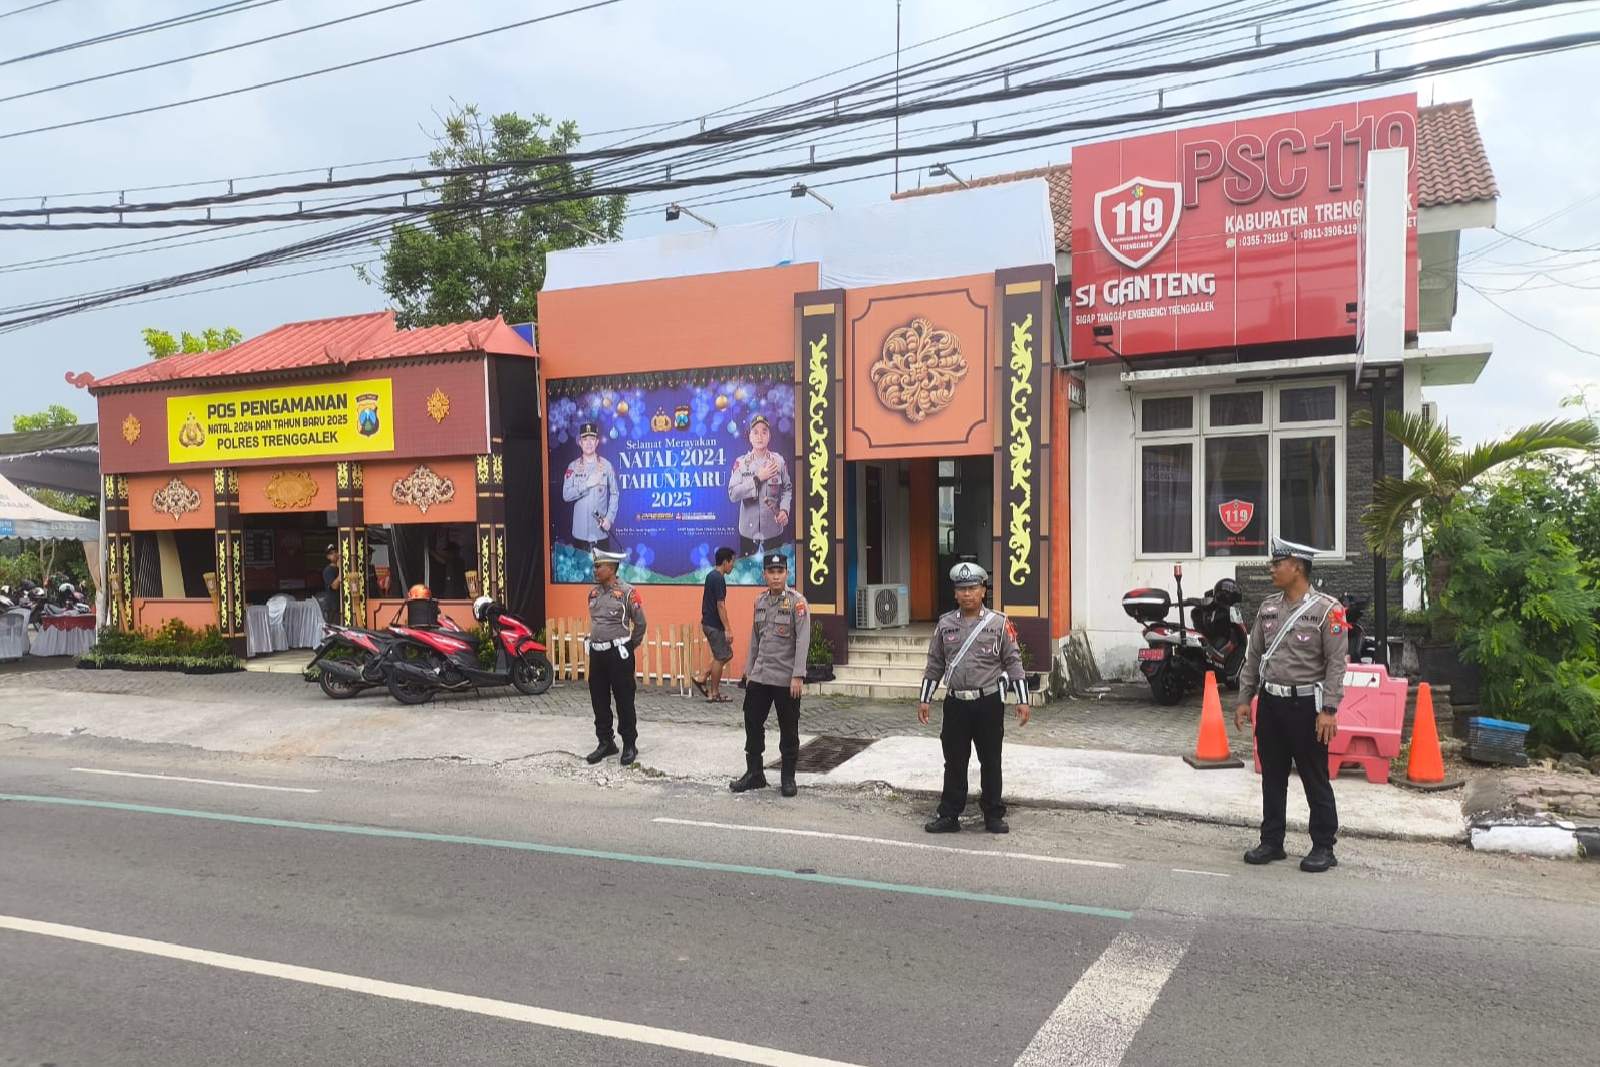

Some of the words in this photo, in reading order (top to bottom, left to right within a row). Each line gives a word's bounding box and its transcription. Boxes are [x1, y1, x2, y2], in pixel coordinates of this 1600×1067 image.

[1182, 127, 1308, 208] PSC
[1111, 197, 1164, 236] 119
[1225, 206, 1308, 233] KABUPATEN
[1075, 284, 1096, 308] SI
[1103, 273, 1216, 306] GANTENG
[1075, 314, 1096, 325] SIGAP
[1096, 311, 1127, 323] TANGGAP
[1127, 305, 1168, 319] EMERGENCY
[1168, 301, 1215, 315] TRENGGALEK
[207, 403, 237, 420] POS
[241, 393, 348, 417] PENGAMANAN
[207, 423, 233, 435] NATAL
[234, 421, 254, 433] 2024
[255, 419, 272, 432] DAN
[273, 418, 301, 430] TAHUN
[302, 416, 325, 428] BARU
[327, 414, 348, 425] 2025
[217, 436, 260, 450] POLRES
[261, 431, 339, 448] TRENGGALEK
[626, 439, 662, 449] Selamat
[665, 437, 717, 450] Merayakan
[619, 450, 677, 469] NATAL
[680, 448, 727, 466] 2024
[619, 472, 676, 490] TAHUN
[680, 471, 726, 488] BARU
[651, 491, 692, 508] 2025
[1225, 509, 1248, 522] 119
